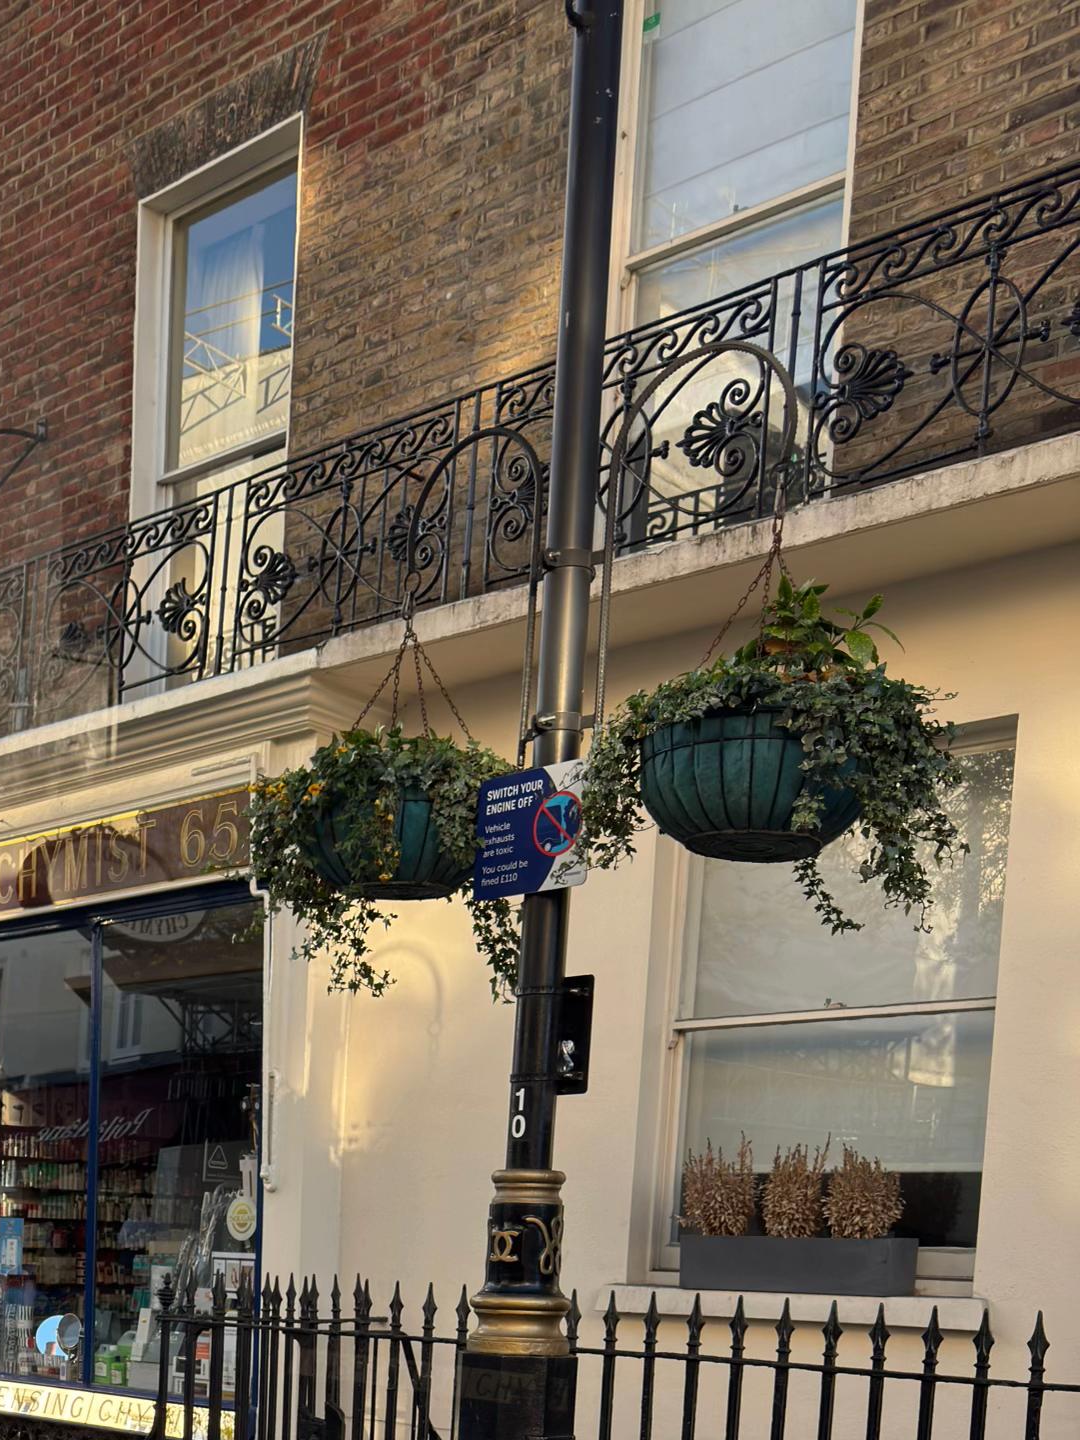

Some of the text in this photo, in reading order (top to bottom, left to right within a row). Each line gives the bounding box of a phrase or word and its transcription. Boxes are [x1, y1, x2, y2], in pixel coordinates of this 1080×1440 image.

[487, 780, 544, 801] SWITCH YOUR
[486, 796, 534, 816] ENGINE OFF
[180, 801, 239, 868] 65
[485, 822, 511, 834] Vehicle
[484, 833, 515, 845] exhausts
[483, 845, 514, 858] are toxic
[482, 859, 529, 875] You could be
[481, 873, 518, 887] fined £110
